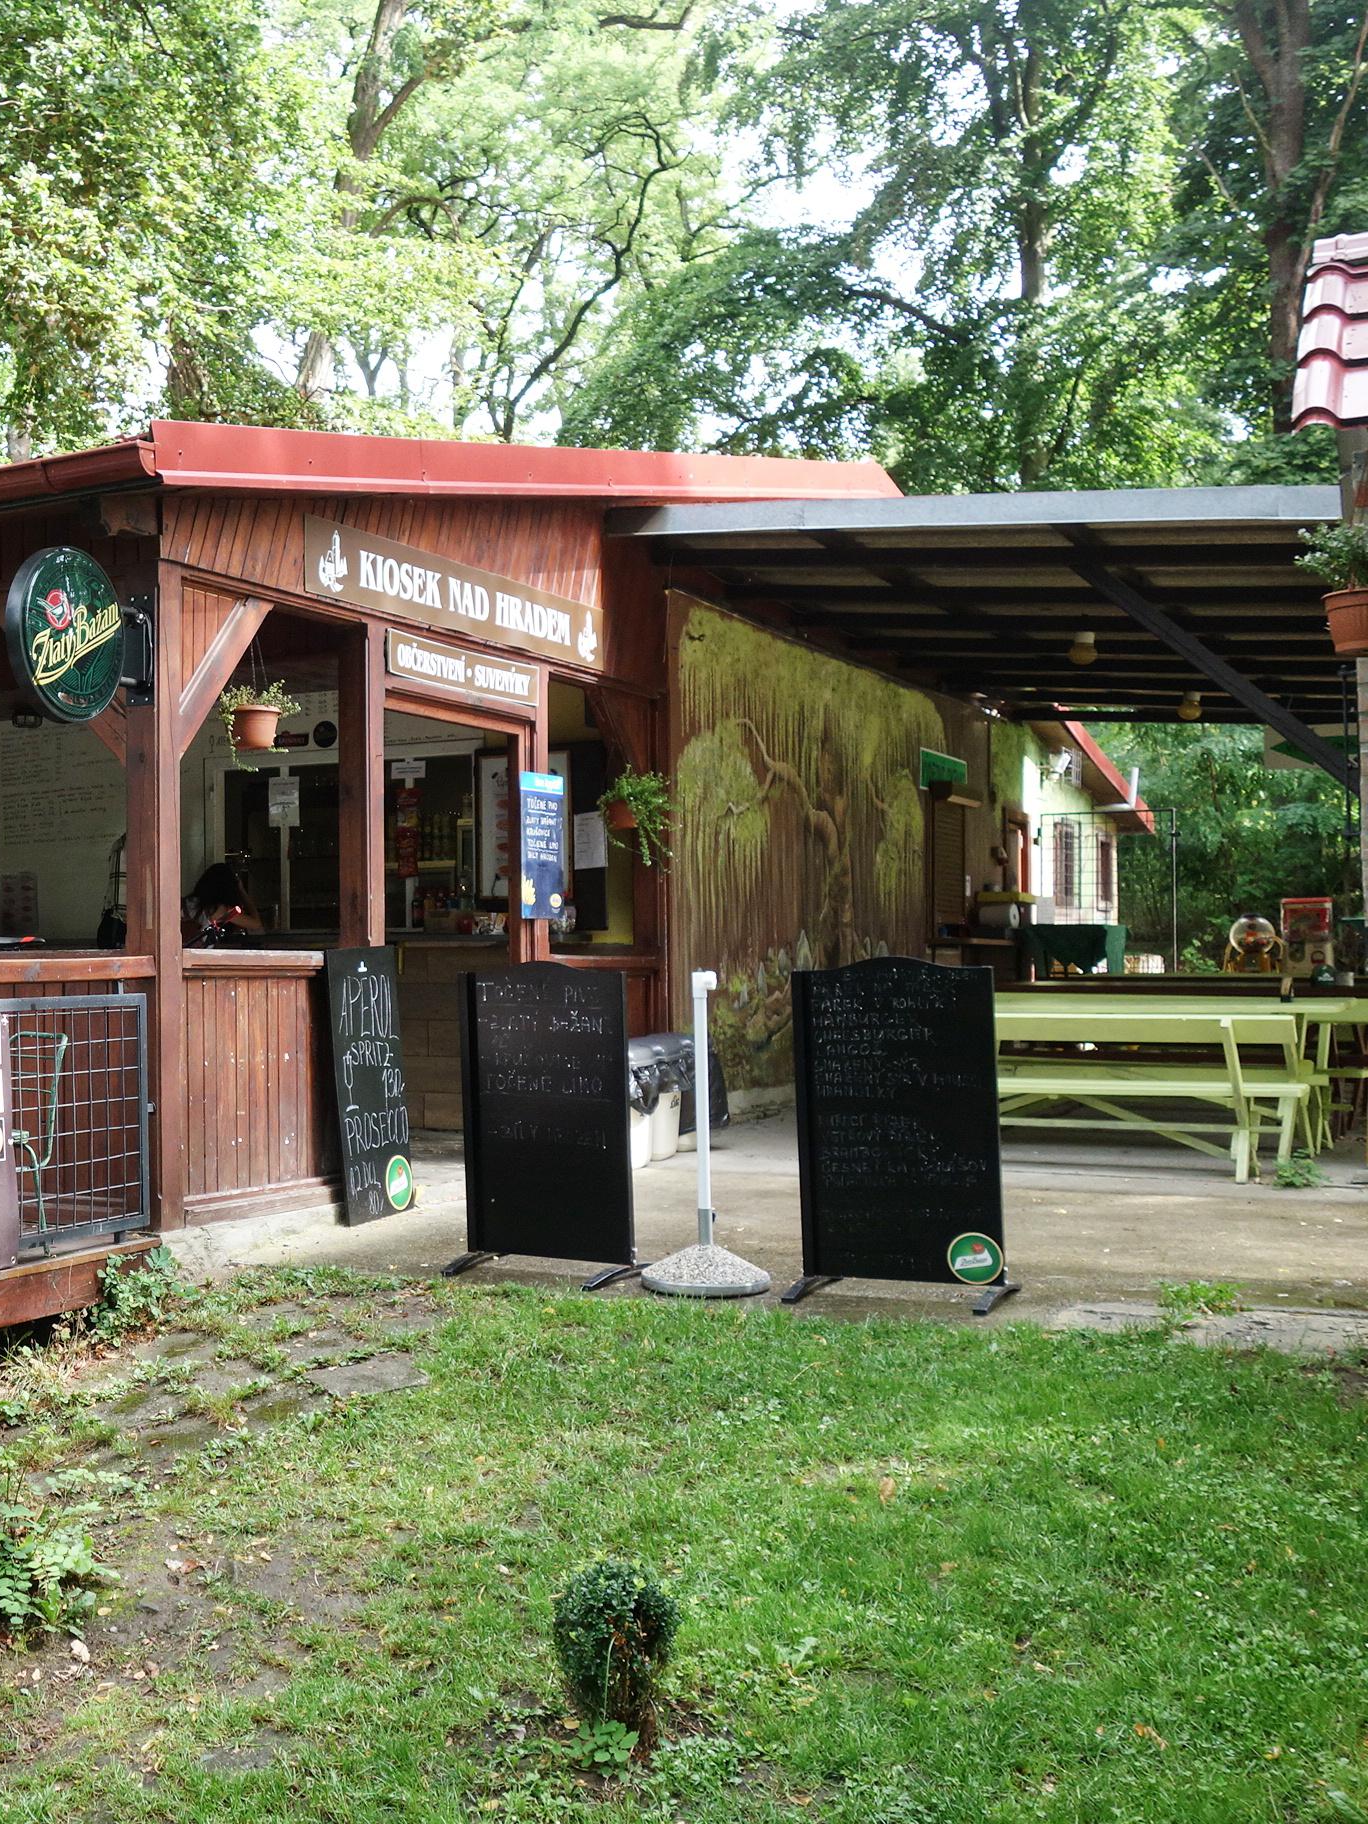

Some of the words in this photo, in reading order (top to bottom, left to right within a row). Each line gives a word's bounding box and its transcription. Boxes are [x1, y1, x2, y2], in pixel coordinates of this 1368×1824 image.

[359, 550, 443, 609] KIOSEK
[448, 577, 490, 621] NAD
[495, 592, 572, 646] HRADEM
[32, 628, 78, 684] Zlatý
[397, 642, 466, 683] OBČERSTVENÍ
[474, 664, 531, 696] SUVENÝRY
[339, 975, 400, 1041] APEROL
[351, 1040, 394, 1067] SPRITZ
[344, 1106, 409, 1156] PROSECCO
